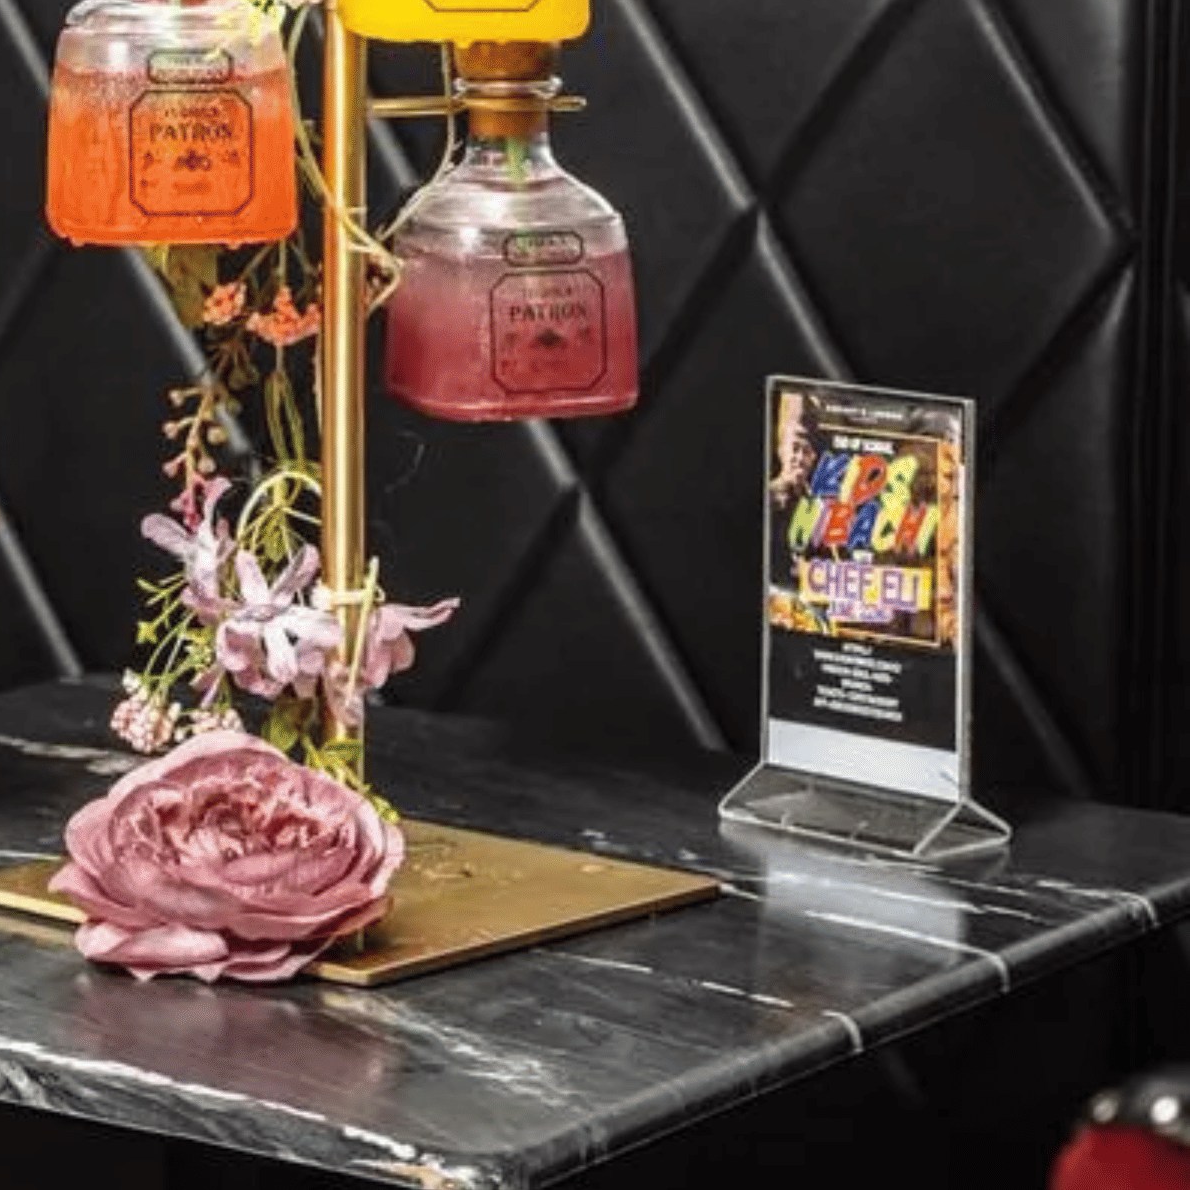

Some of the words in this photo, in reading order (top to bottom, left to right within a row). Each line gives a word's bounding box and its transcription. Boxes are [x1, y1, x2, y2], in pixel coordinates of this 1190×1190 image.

[809, 450, 919, 508] KIDS
[808, 559, 874, 601] CHEF
[880, 569, 920, 612] ELI
